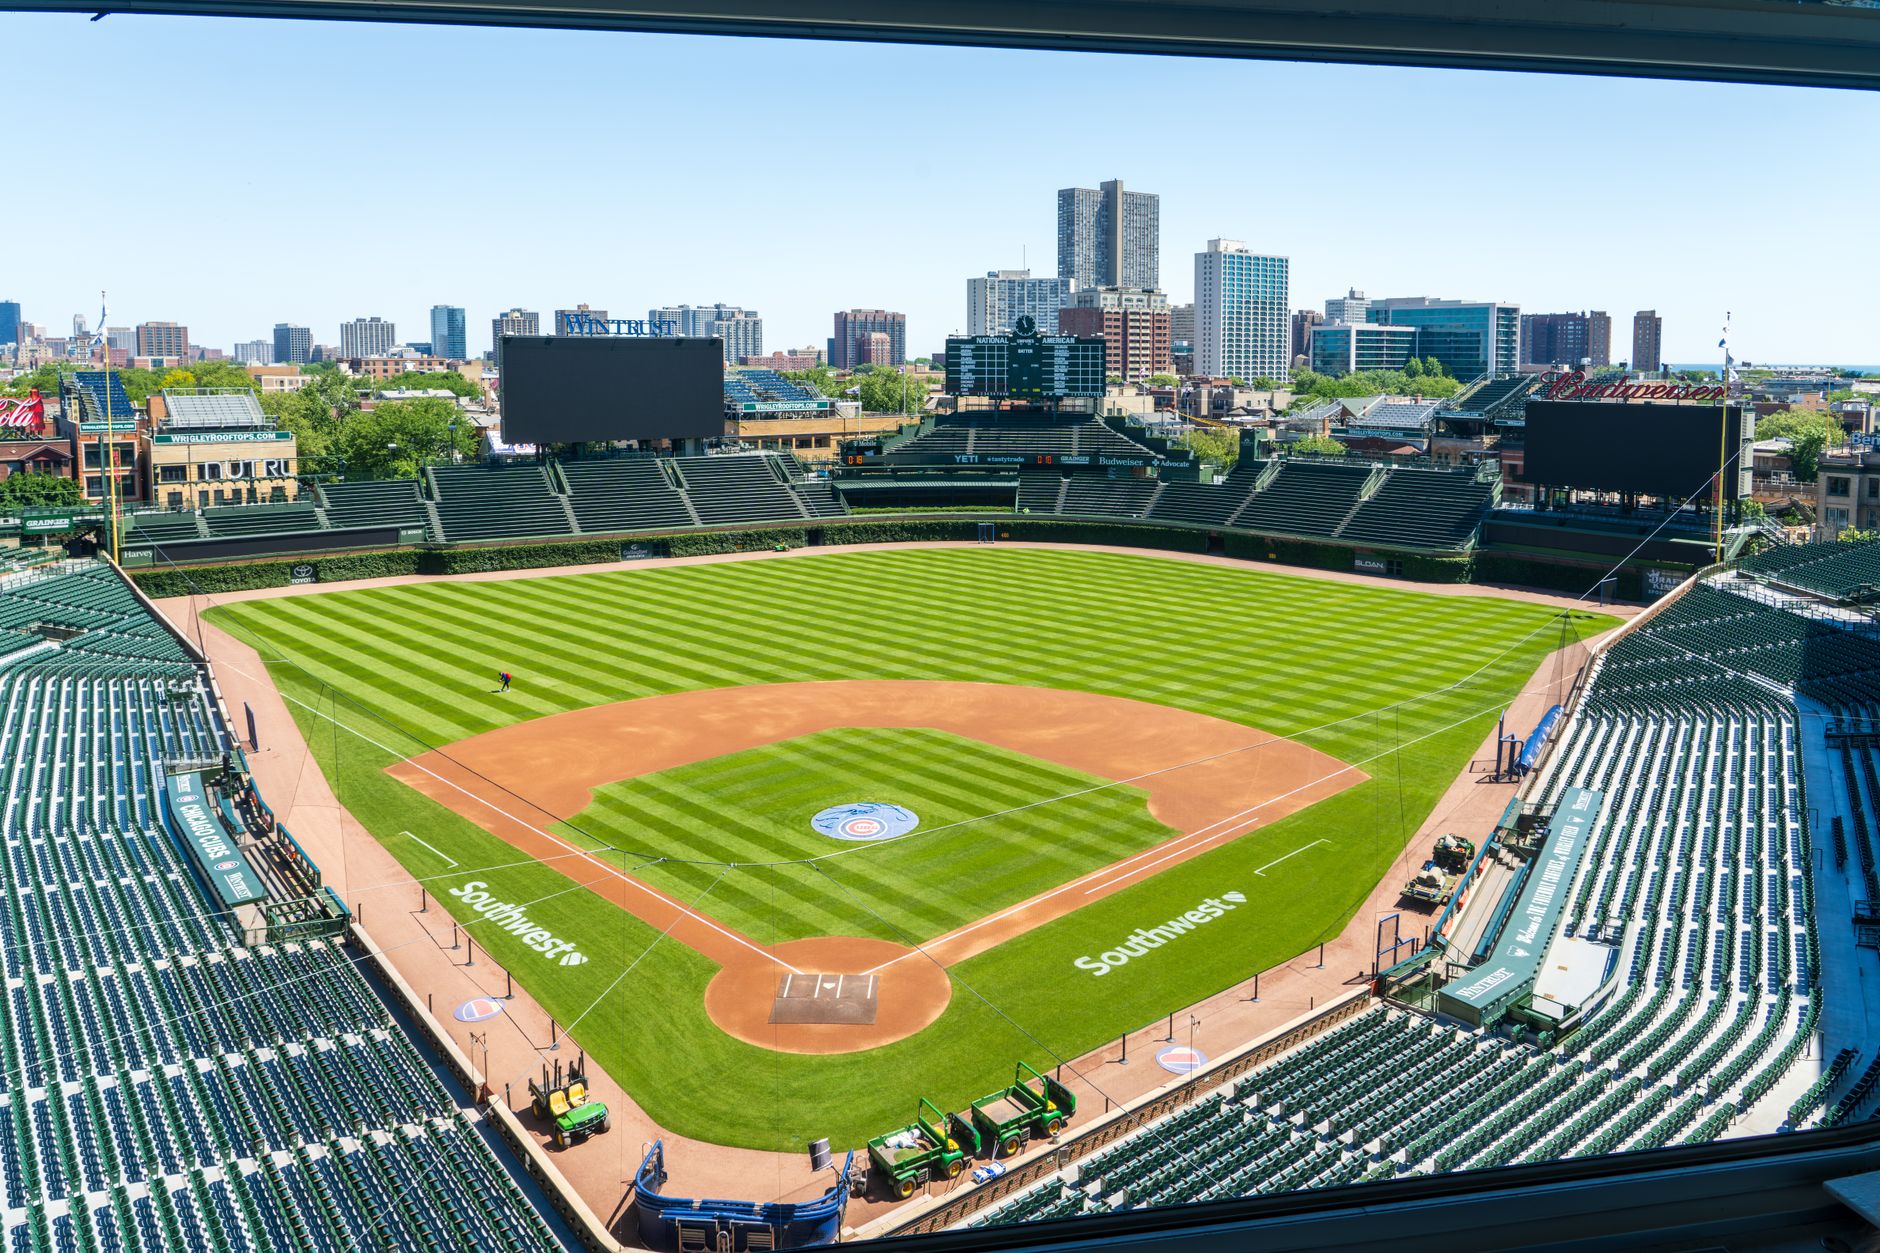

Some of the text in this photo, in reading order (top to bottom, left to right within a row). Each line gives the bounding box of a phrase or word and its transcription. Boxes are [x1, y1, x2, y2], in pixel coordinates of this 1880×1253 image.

[564, 313, 678, 336] WINTRUST
[1540, 370, 1731, 401] Budweiser
[171, 432, 276, 443] WRIGLEYROOFTOPS.COM
[954, 455, 978, 463] YETI
[991, 456, 1025, 464] tastytrade
[1160, 460, 1190, 468] Advocate
[25, 518, 70, 527] GRAINGER
[124, 550, 153, 559] Harvey
[1354, 559, 1384, 569] SLOAN
[291, 577, 316, 585] TOYOTA
[179, 804, 230, 860] CHICAGO CUBS
[448, 881, 576, 959] Southwest
[1074, 897, 1237, 977] Southwest
[1455, 967, 1510, 999] WINTRUST
